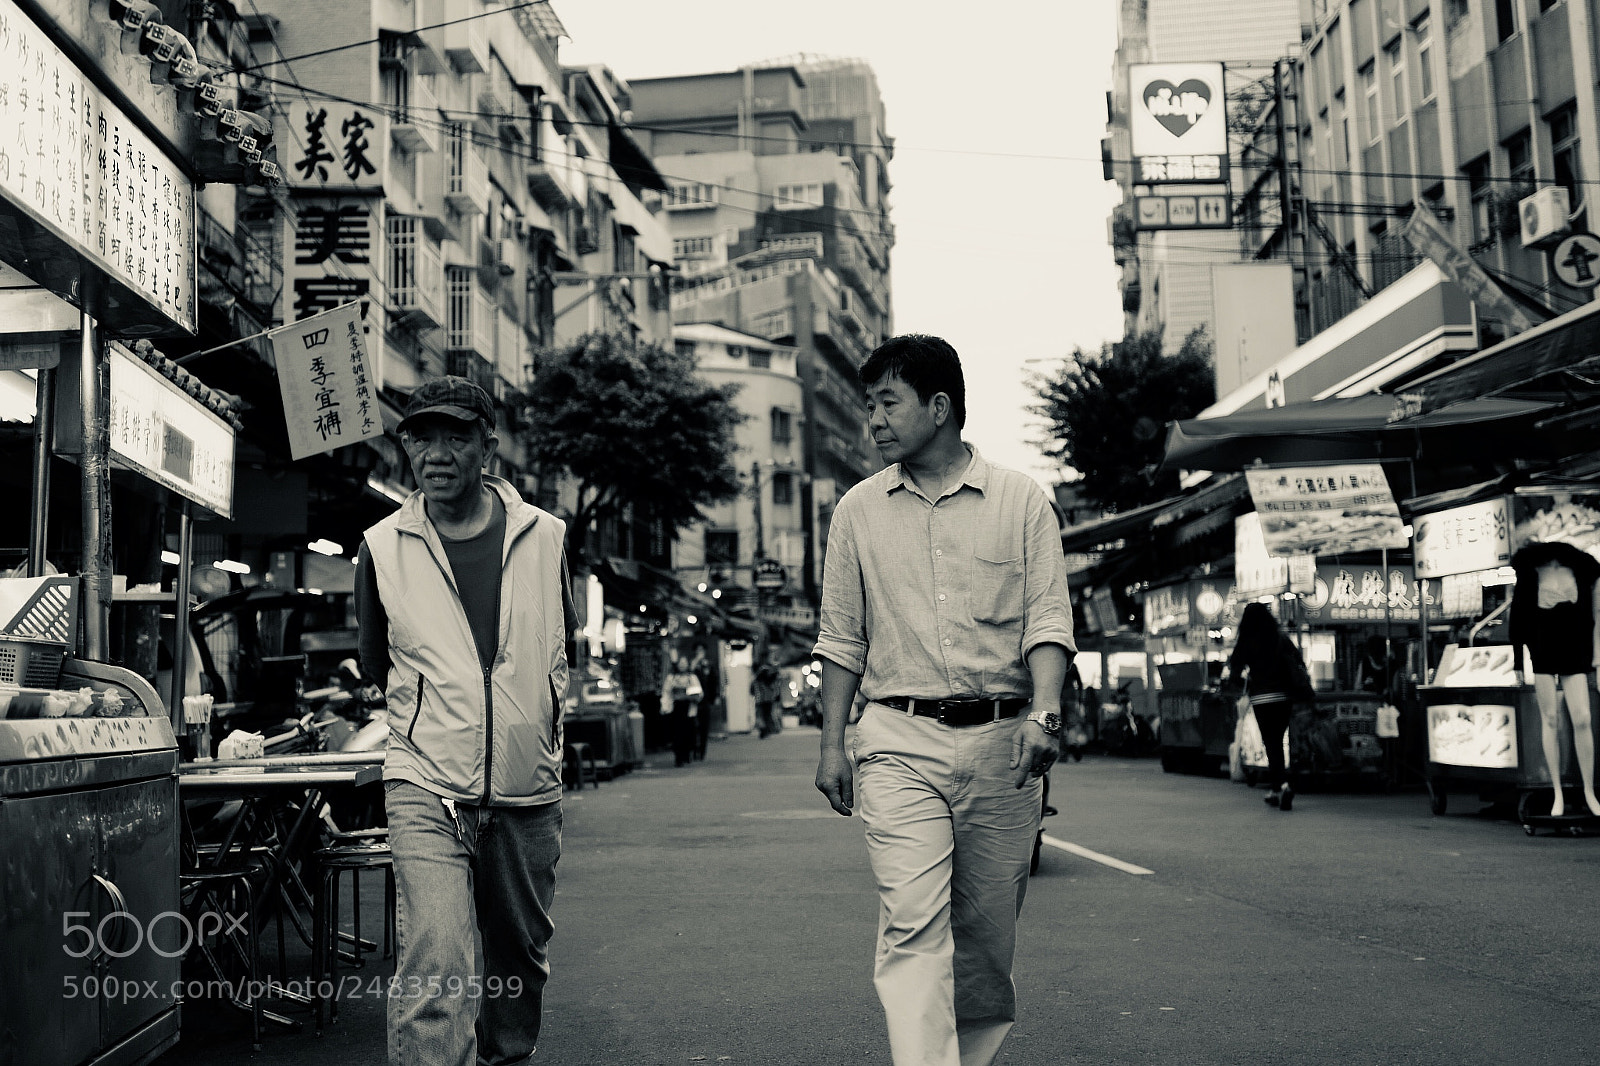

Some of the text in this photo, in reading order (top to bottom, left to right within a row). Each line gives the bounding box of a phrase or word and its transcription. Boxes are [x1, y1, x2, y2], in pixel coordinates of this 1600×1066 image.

[294, 108, 377, 183] 美家
[302, 327, 342, 441] 四季宜補
